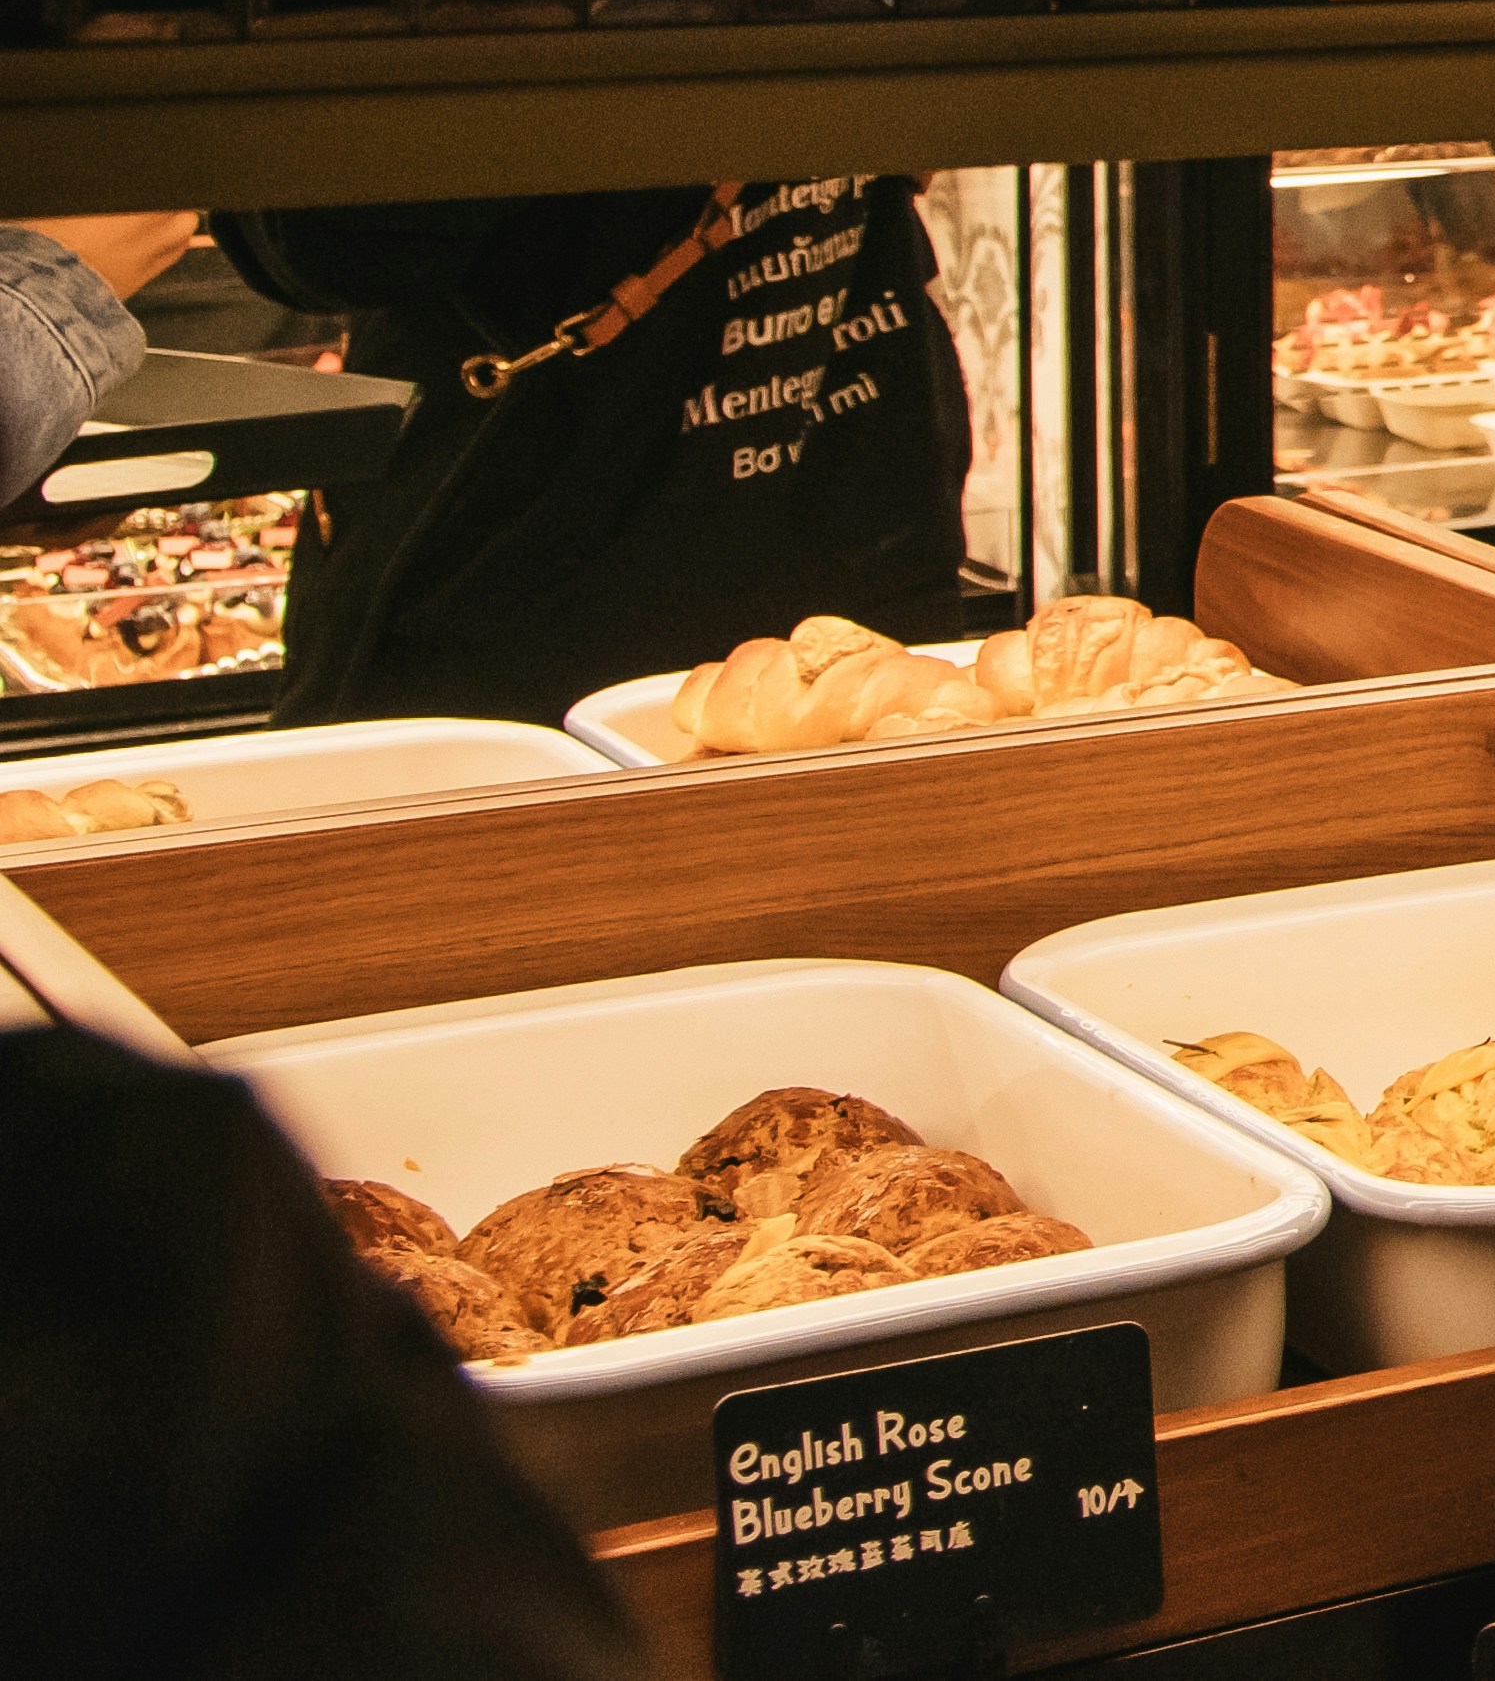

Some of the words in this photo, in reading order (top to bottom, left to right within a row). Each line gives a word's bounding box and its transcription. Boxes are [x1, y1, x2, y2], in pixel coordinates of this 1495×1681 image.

[832, 290, 909, 352] roti
[730, 1422, 863, 1486] English
[876, 1409, 967, 1457] Rose
[732, 1481, 912, 1546] Blueberry
[926, 1456, 1034, 1502] Scone
